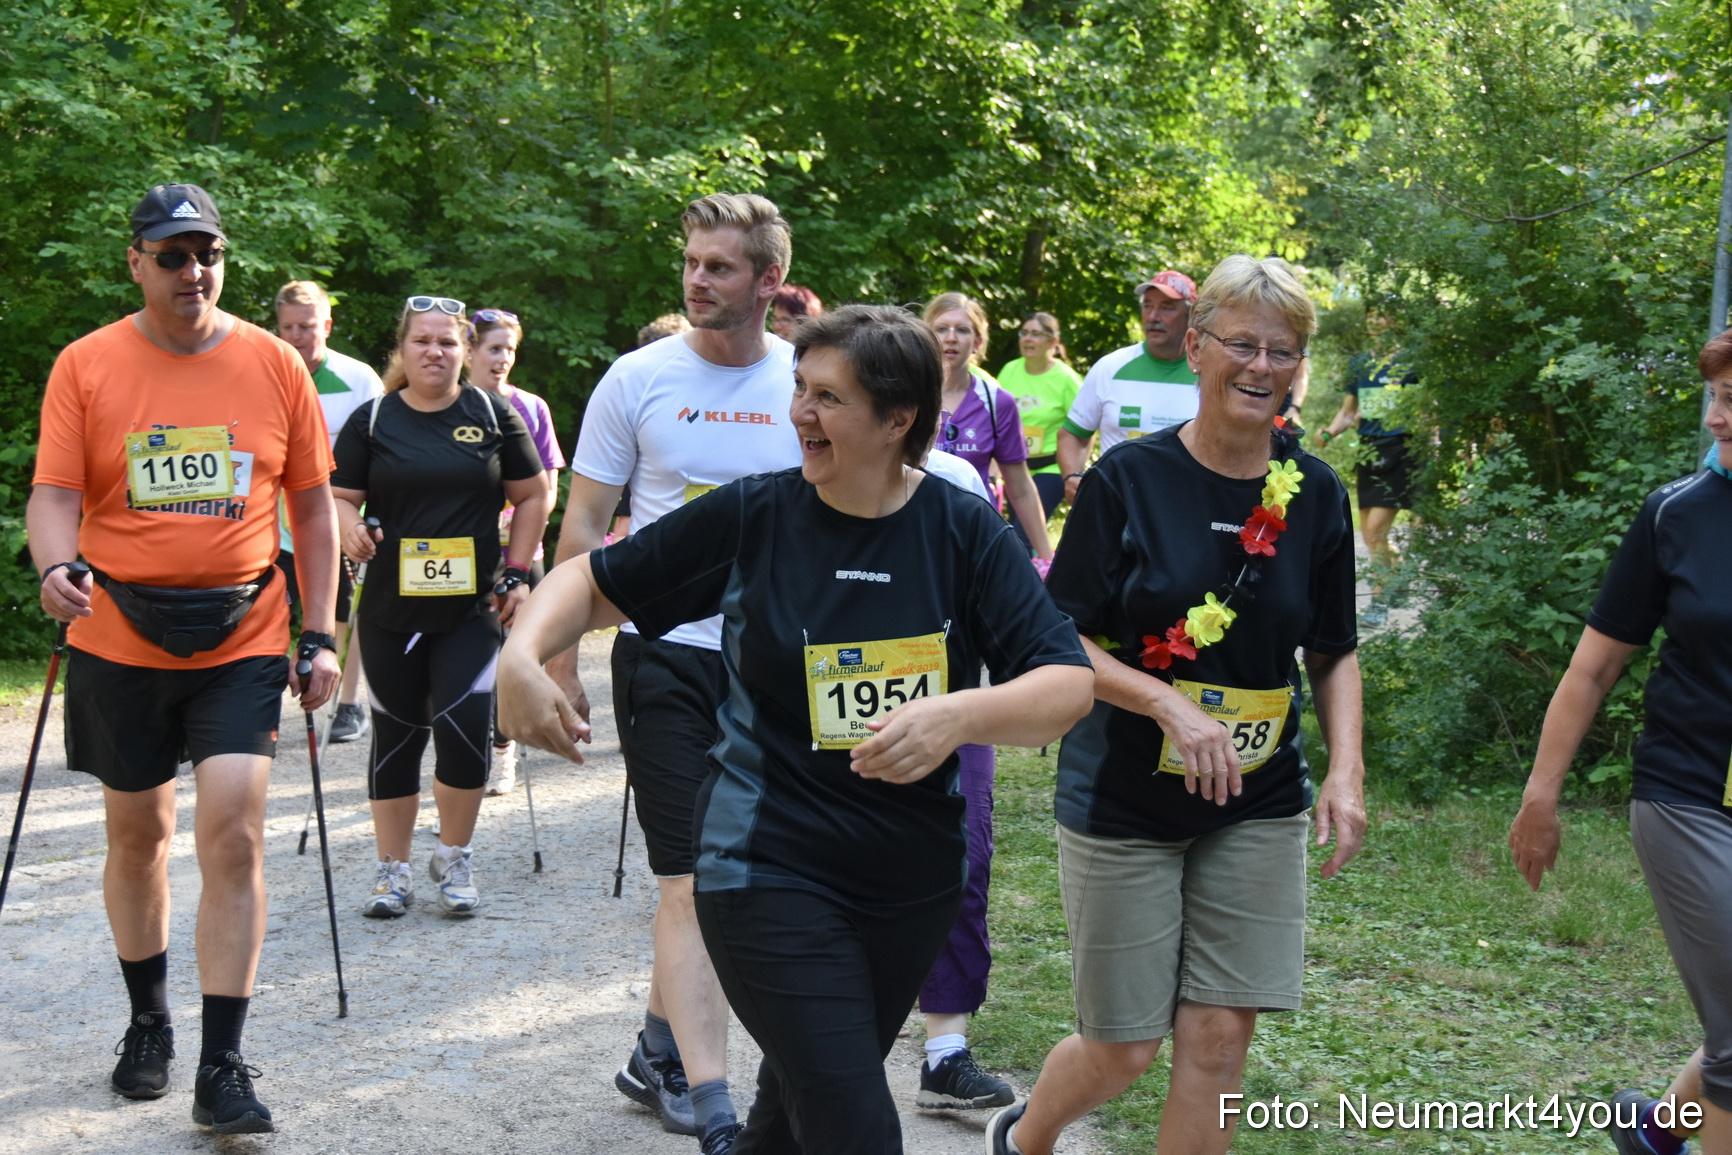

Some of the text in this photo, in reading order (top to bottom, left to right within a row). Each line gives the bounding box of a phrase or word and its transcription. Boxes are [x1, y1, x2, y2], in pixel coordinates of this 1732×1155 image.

[704, 411, 778, 425] KLEBL
[142, 453, 218, 484] 1160
[186, 480, 216, 489] Michael
[424, 559, 452, 579] 64
[835, 570, 891, 583] STANNO
[829, 660, 885, 676] firmenlauf
[891, 661, 940, 676] walk 2019
[827, 673, 931, 719] 1954
[820, 730, 875, 740] Regens Wagner
[1217, 720, 1271, 752] 58
[1238, 752, 1258, 760] hrista
